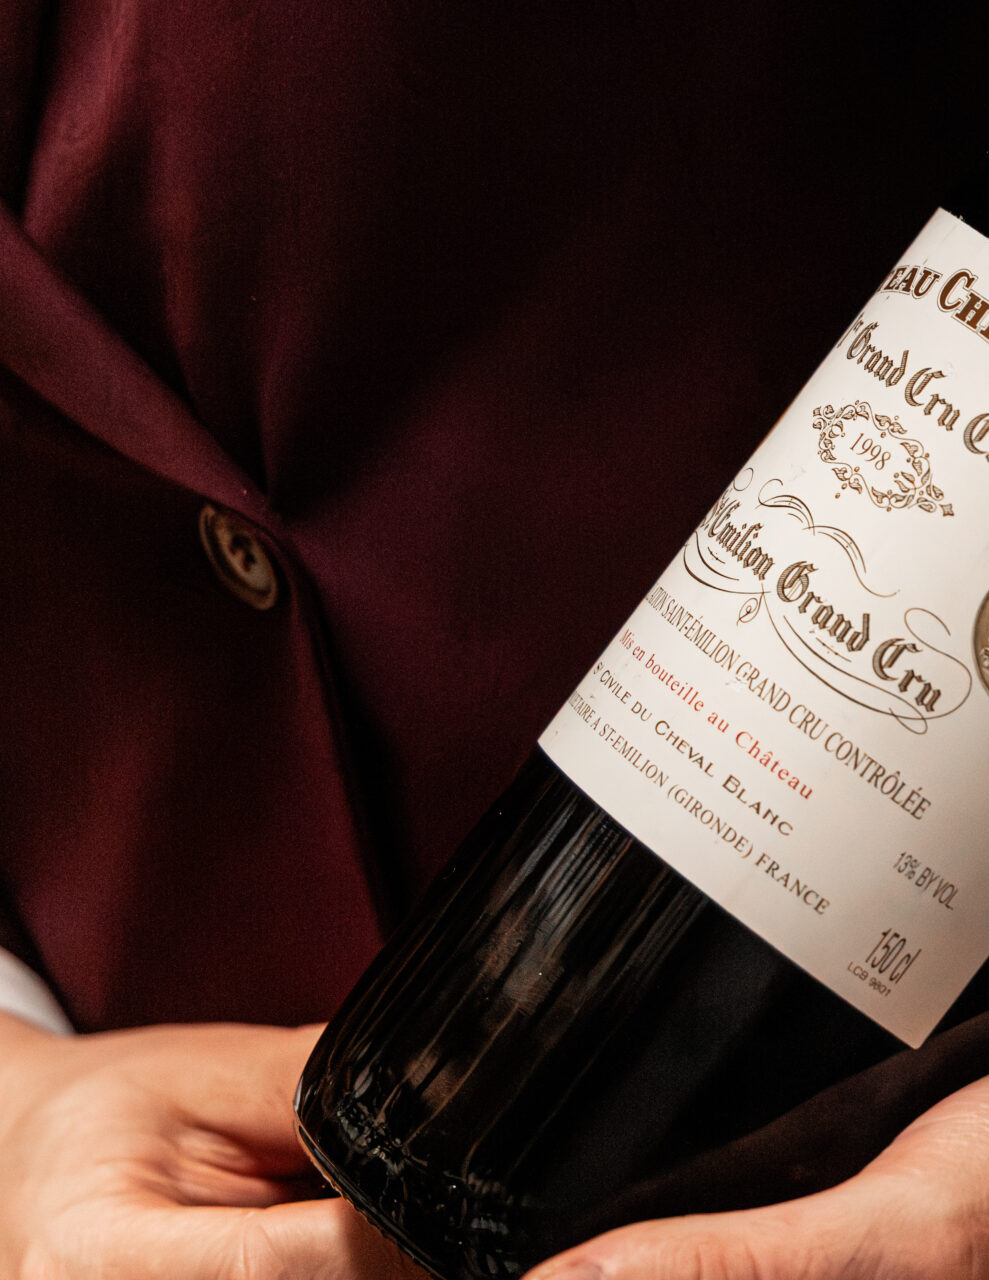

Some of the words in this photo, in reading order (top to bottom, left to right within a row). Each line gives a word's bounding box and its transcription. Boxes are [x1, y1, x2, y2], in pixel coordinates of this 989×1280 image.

[878, 265, 943, 300] EAU
[846, 321, 910, 387] Grand
[904, 367, 961, 431] Cru
[850, 433, 892, 470] 1998
[776, 560, 870, 653] Grand
[872, 637, 942, 712] Cru
[599, 668, 633, 705] CIVILE
[630, 700, 654, 723] DU
[654, 719, 716, 778] CHEVAL
[722, 774, 795, 837] BLANC
[618, 627, 635, 651] Mis
[632, 645, 647, 662] en
[645, 653, 705, 713] bouteille
[707, 711, 731, 734] au
[735, 730, 815, 800] Château
[661, 598, 741, 671] SAINT-ÉMILION
[735, 661, 791, 713] GRAND
[788, 704, 830, 741] CRU
[824, 732, 932, 820] CONTRÔLÉE
[598, 723, 670, 788] ST-EMILION
[666, 783, 754, 860] (GIRONDE)
[755, 852, 831, 916] FRANCE
[893, 851, 921, 880] 13%
[914, 866, 941, 893] BY
[933, 878, 959, 911] VOL
[865, 928, 907, 974] 150
[889, 948, 922, 984] cl
